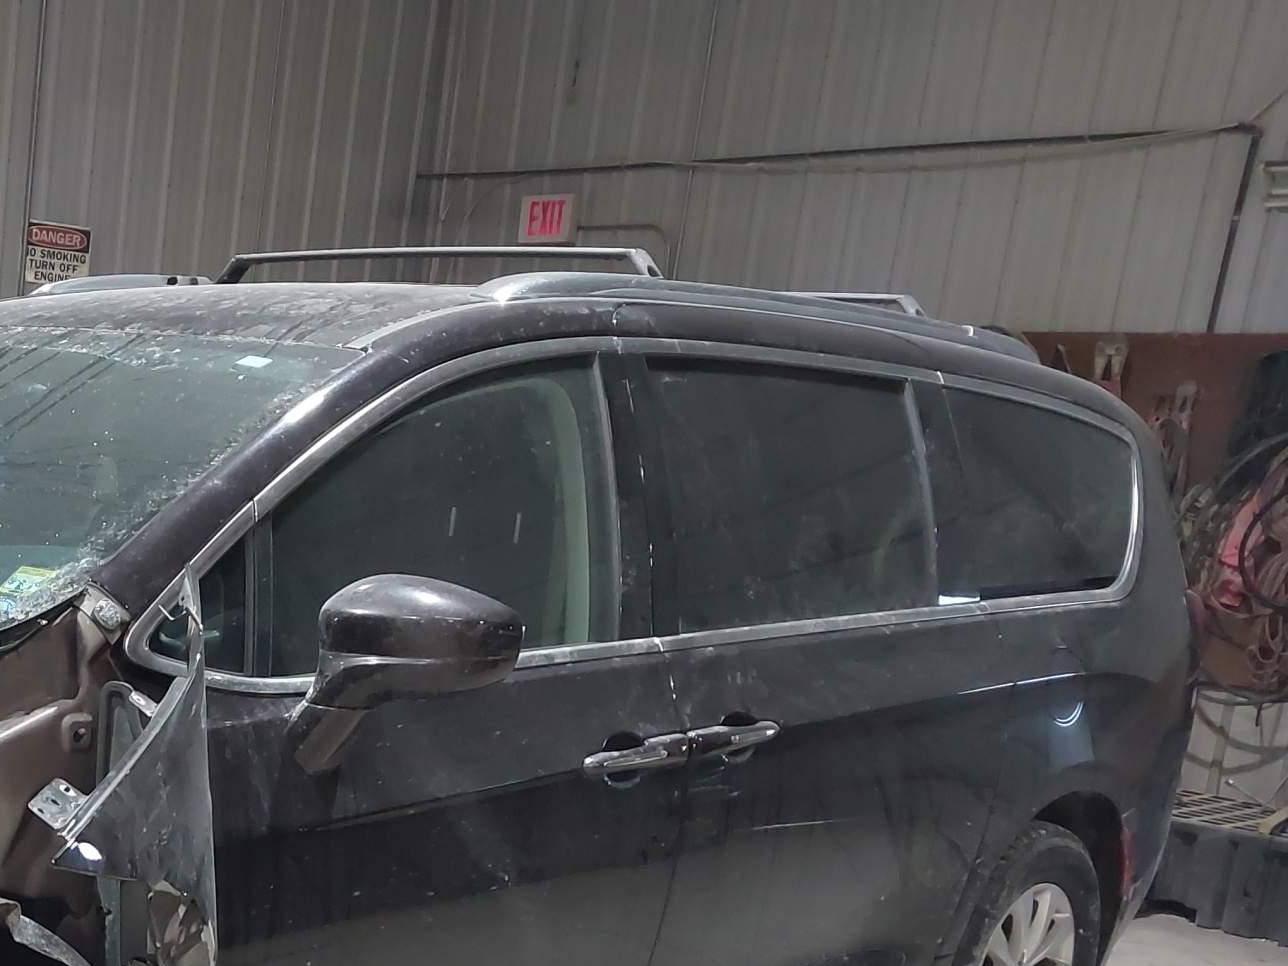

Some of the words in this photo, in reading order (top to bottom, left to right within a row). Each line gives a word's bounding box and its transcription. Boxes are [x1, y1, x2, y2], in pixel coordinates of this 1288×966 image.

[527, 201, 566, 236] EXIT
[32, 229, 82, 248] DANGER
[40, 249, 87, 265] SMOKING
[28, 258, 55, 271] TURN
[59, 263, 79, 274] OFF
